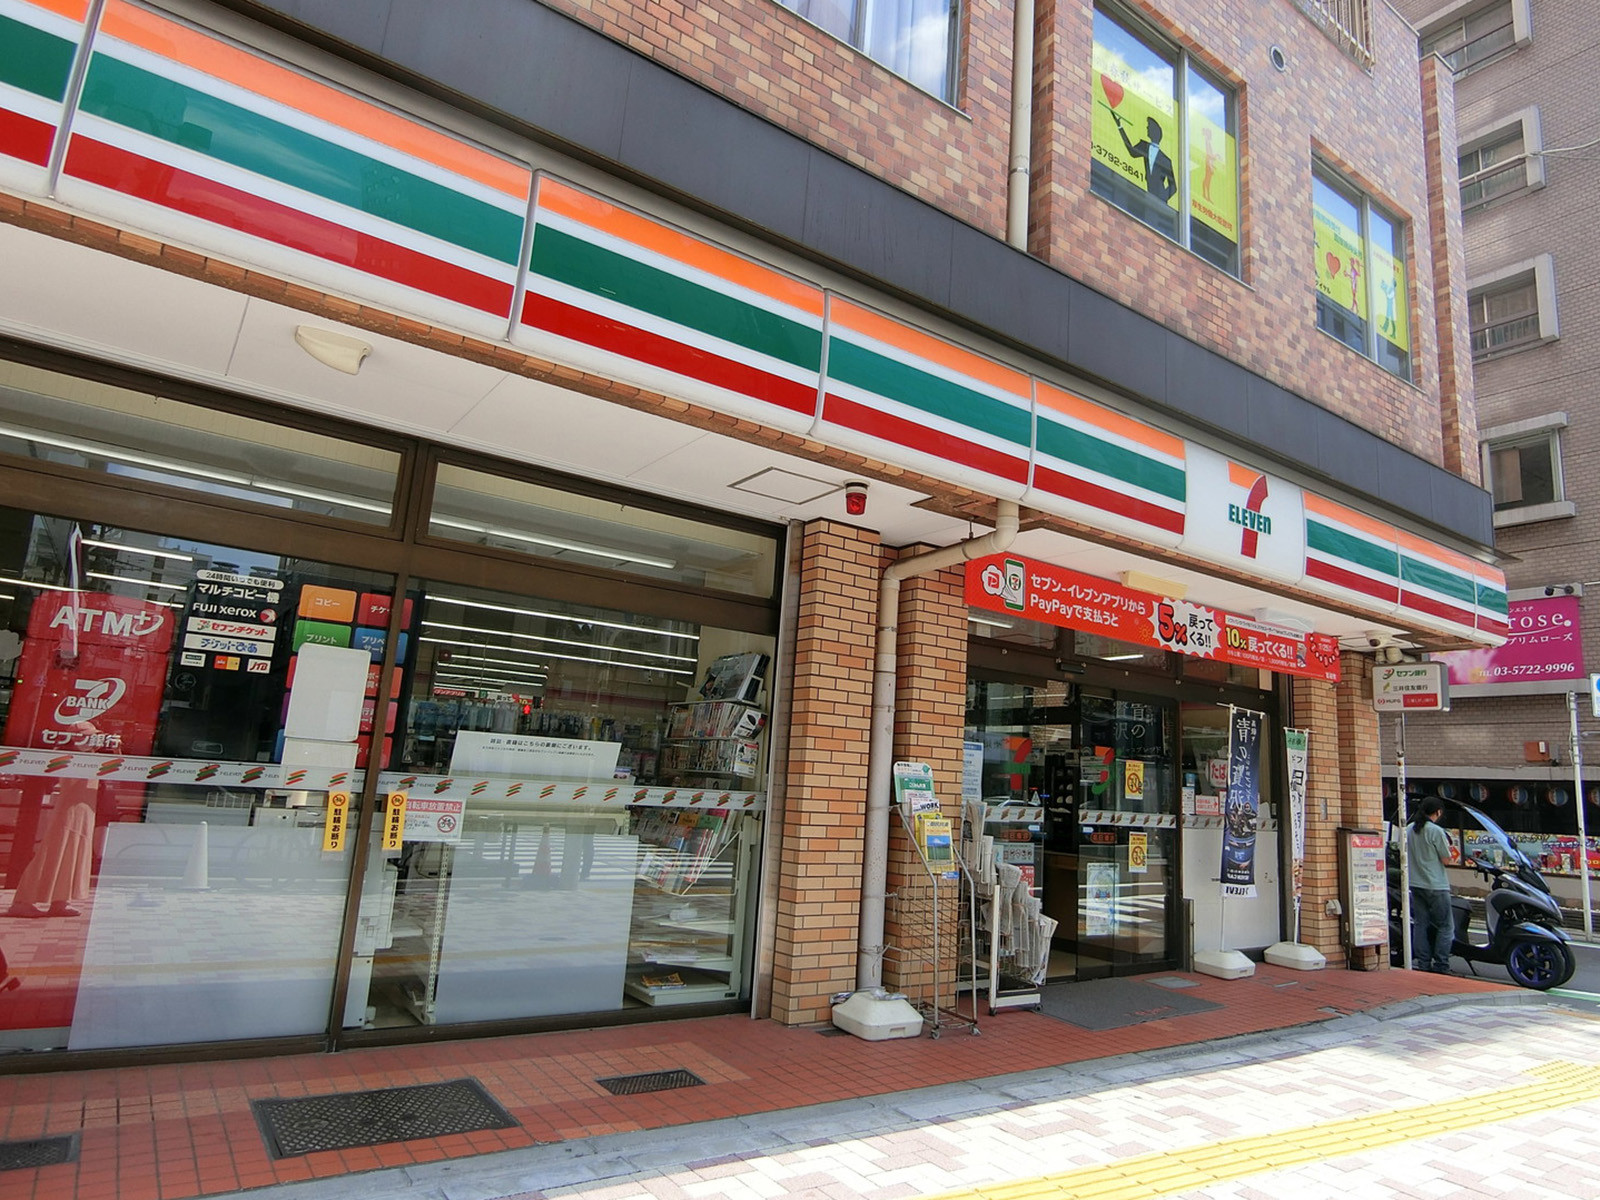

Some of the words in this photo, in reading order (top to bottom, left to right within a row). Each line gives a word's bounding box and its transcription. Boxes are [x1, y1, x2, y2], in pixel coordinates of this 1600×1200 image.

[197, 583, 280, 605] マルチコピー機
[192, 602, 217, 613] FUJI
[315, 597, 341, 607] コピー
[1030, 593, 1119, 627] PayPayで支払うと
[211, 622, 268, 636] セブンチケット
[1189, 613, 1214, 631] 戻って
[306, 634, 337, 645] プリント
[249, 662, 269, 671] JTB
[1396, 669, 1427, 678] セブン銀行
[1494, 662, 1575, 676] 03-5722-9996
[1393, 684, 1428, 692] 三井住友銀行
[66, 696, 110, 710] BANK
[42, 729, 122, 749] セブン銀行
[331, 808, 342, 849] 駐輪お断り
[389, 808, 400, 848] 駐輪お断り
